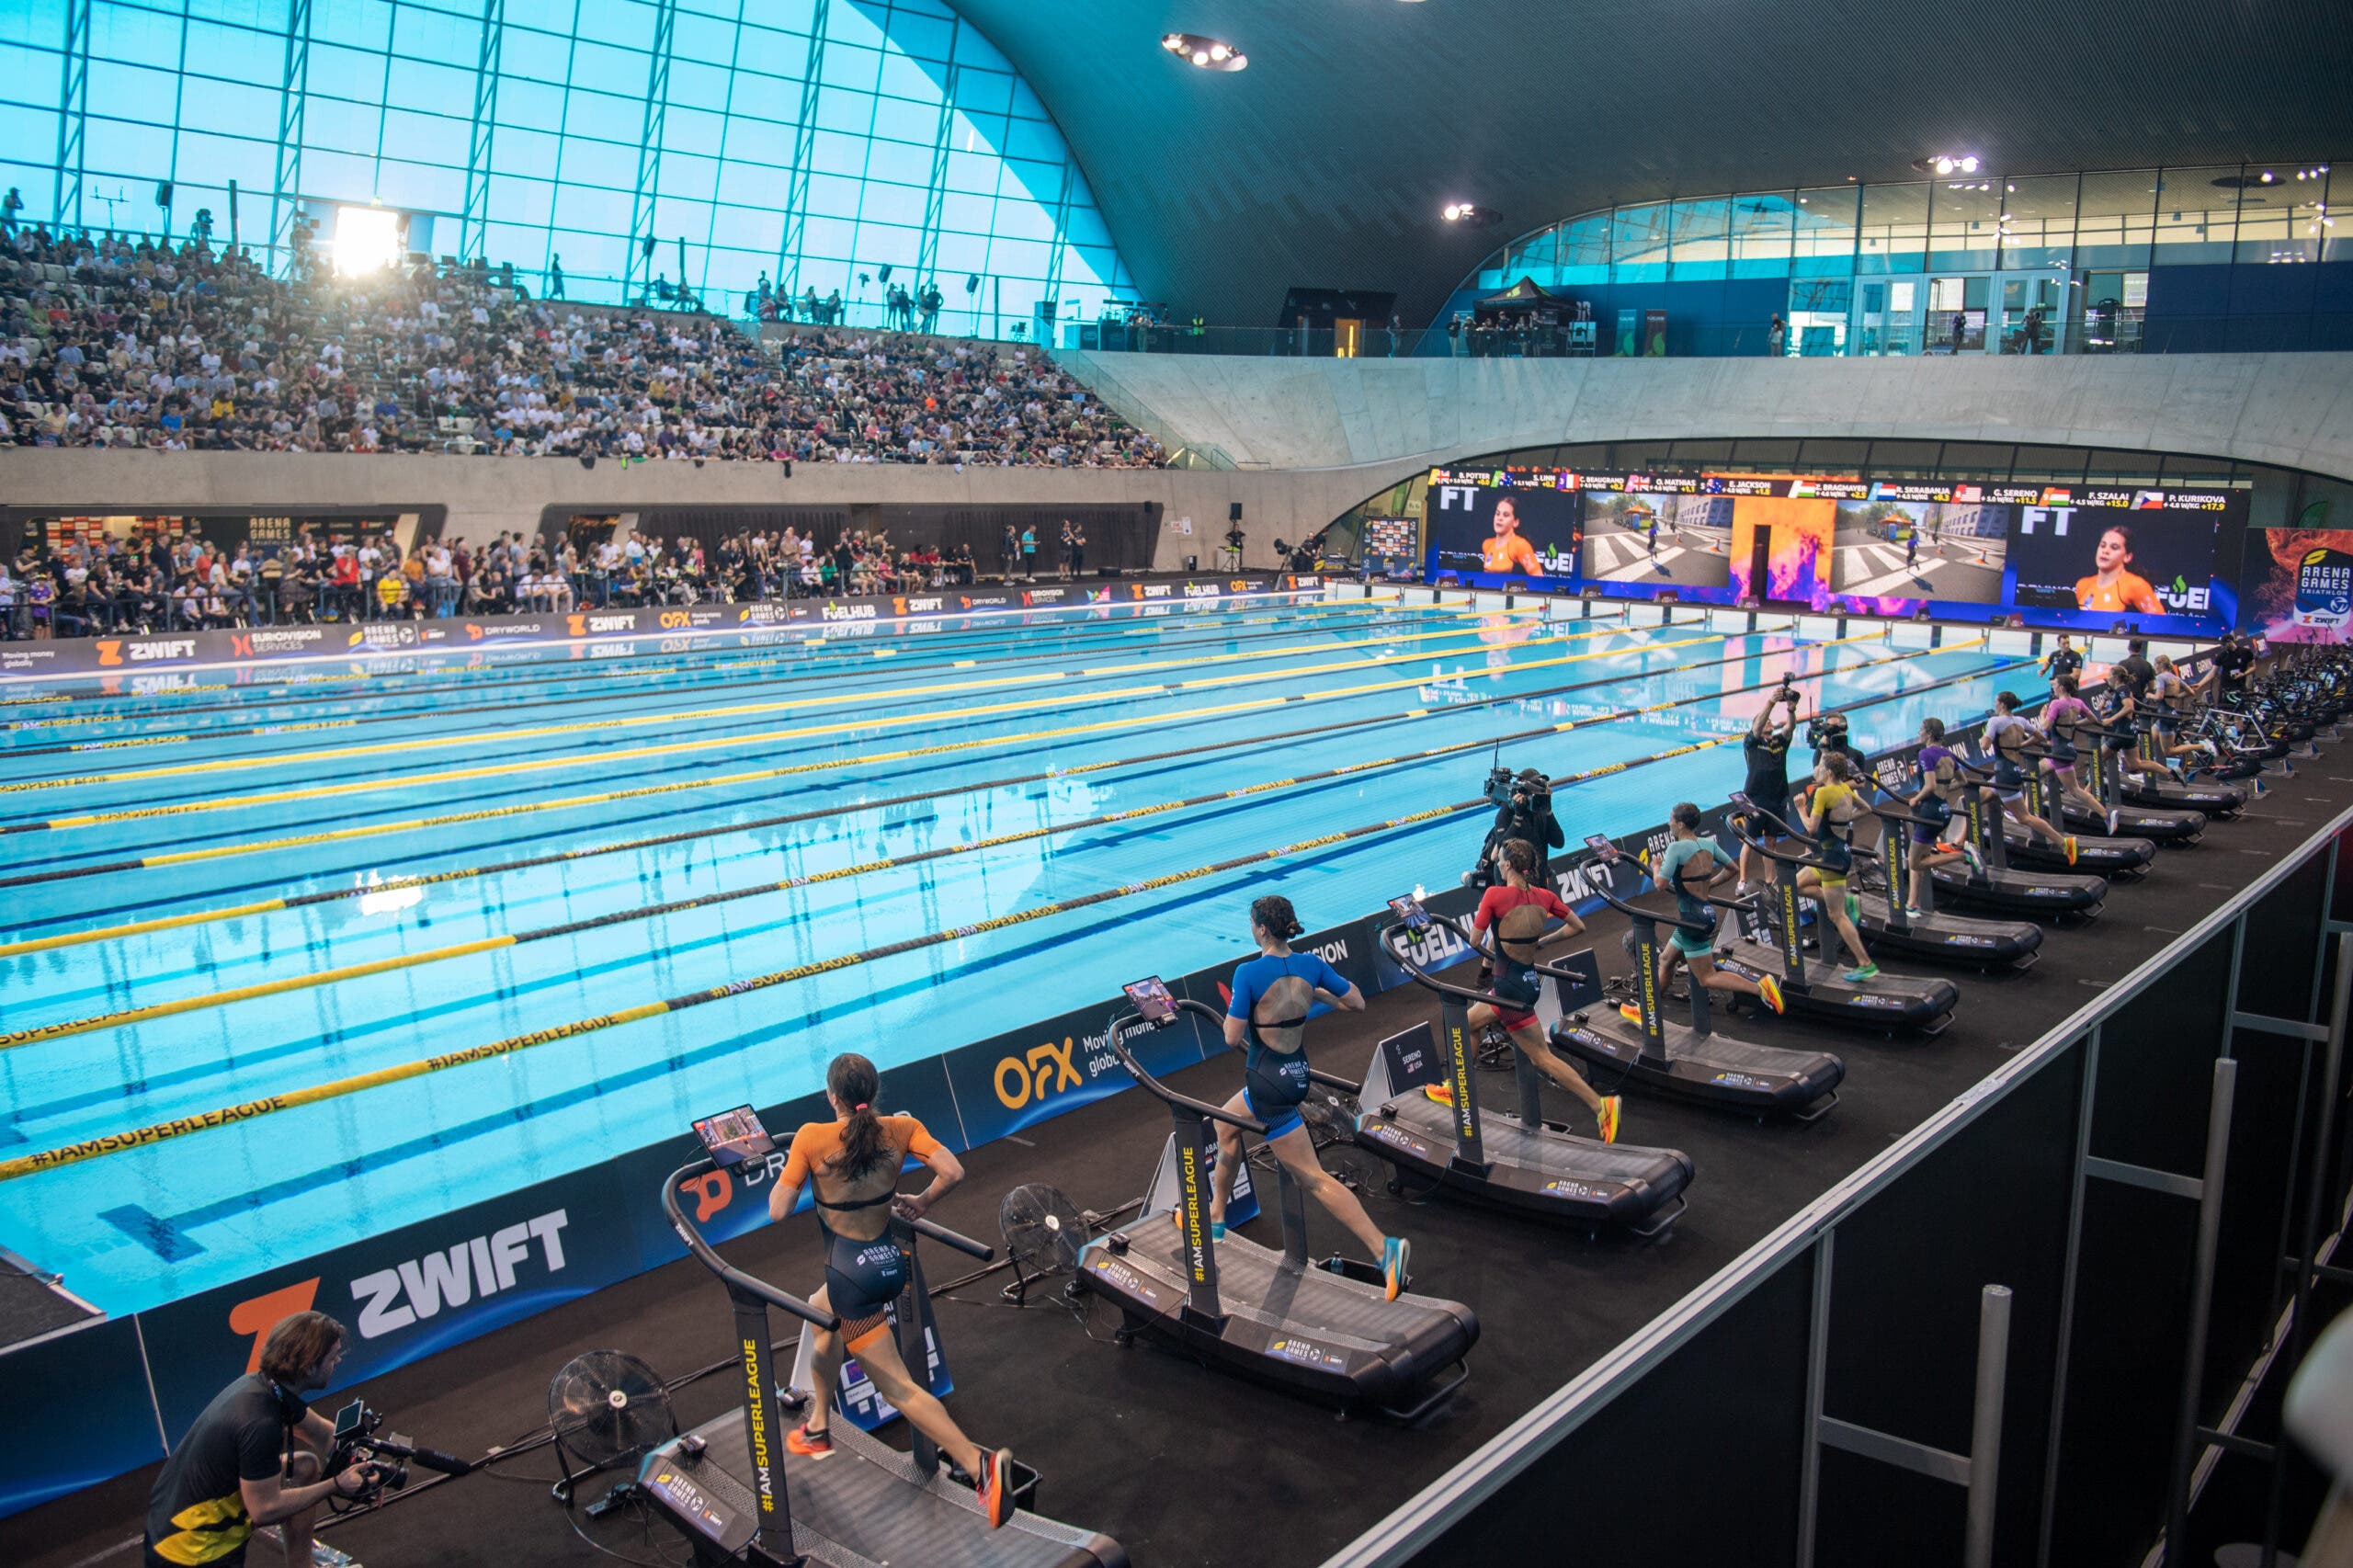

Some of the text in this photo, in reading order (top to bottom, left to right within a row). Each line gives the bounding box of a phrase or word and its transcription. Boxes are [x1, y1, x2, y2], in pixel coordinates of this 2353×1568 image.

[1664, 479, 1696, 487] MATHIAS
[1824, 483, 1868, 492] BRAGMAYER
[2004, 489, 2037, 497] SERENO
[2177, 494, 2226, 504] KURIKOVA
[2200, 503, 2225, 511] +17.9
[250, 517, 291, 529] ARENA
[250, 528, 291, 540] GAMES
[2302, 566, 2350, 579] ARENA
[1230, 579, 1248, 592] OFX
[1298, 576, 1319, 587] ZWIFT
[2302, 577, 2349, 590] GAMES
[1031, 589, 1064, 597] EUROVISION
[1144, 585, 1171, 597] ZWIFT
[1184, 584, 1220, 597] FUELHUB
[909, 597, 943, 612] ZWIFT
[972, 597, 1006, 606] DRYWORLD
[822, 605, 876, 620] FUELHUB
[589, 615, 635, 632] ZWIFT
[660, 611, 690, 629] OFX
[484, 623, 540, 635] DRYWORLD
[252, 630, 322, 643] EUROVISION
[129, 640, 196, 660] ZWIFT
[253, 641, 305, 653] SERVICES
[1877, 757, 1895, 774] ARENA
[943, 903, 1062, 940] #IAMSUPERLEAGUE
[1783, 884, 1798, 966] #IAMSUPERLEAGUE
[710, 952, 862, 999] #IAMSUPERLEAGUE
[1641, 943, 1658, 1037] #IAMSUPERLEAGUE
[426, 1015, 620, 1071] #IAMSUPERLEAGUE
[1403, 1050, 1422, 1064] SERENO
[1414, 1060, 1424, 1070] USA
[994, 1037, 1083, 1109] OFX
[1452, 1027, 1474, 1138] #IAMSUPERLEAGUE
[31, 1096, 287, 1165] #IAMSUPERLEAGUE
[1183, 1147, 1206, 1283] #IAMSUPERLEAGUE
[864, 1244, 890, 1256] ARENA
[868, 1250, 893, 1262] GAMES
[349, 1208, 569, 1340] ZWIFT
[1108, 1263, 1131, 1278] ARENA
[1287, 1339, 1311, 1350] ARENA
[1285, 1346, 1308, 1358] GAMES
[743, 1338, 776, 1513] #IAMSUPERLEAGUE
[672, 1474, 697, 1497] ARENA
[667, 1483, 691, 1505] GAMES
